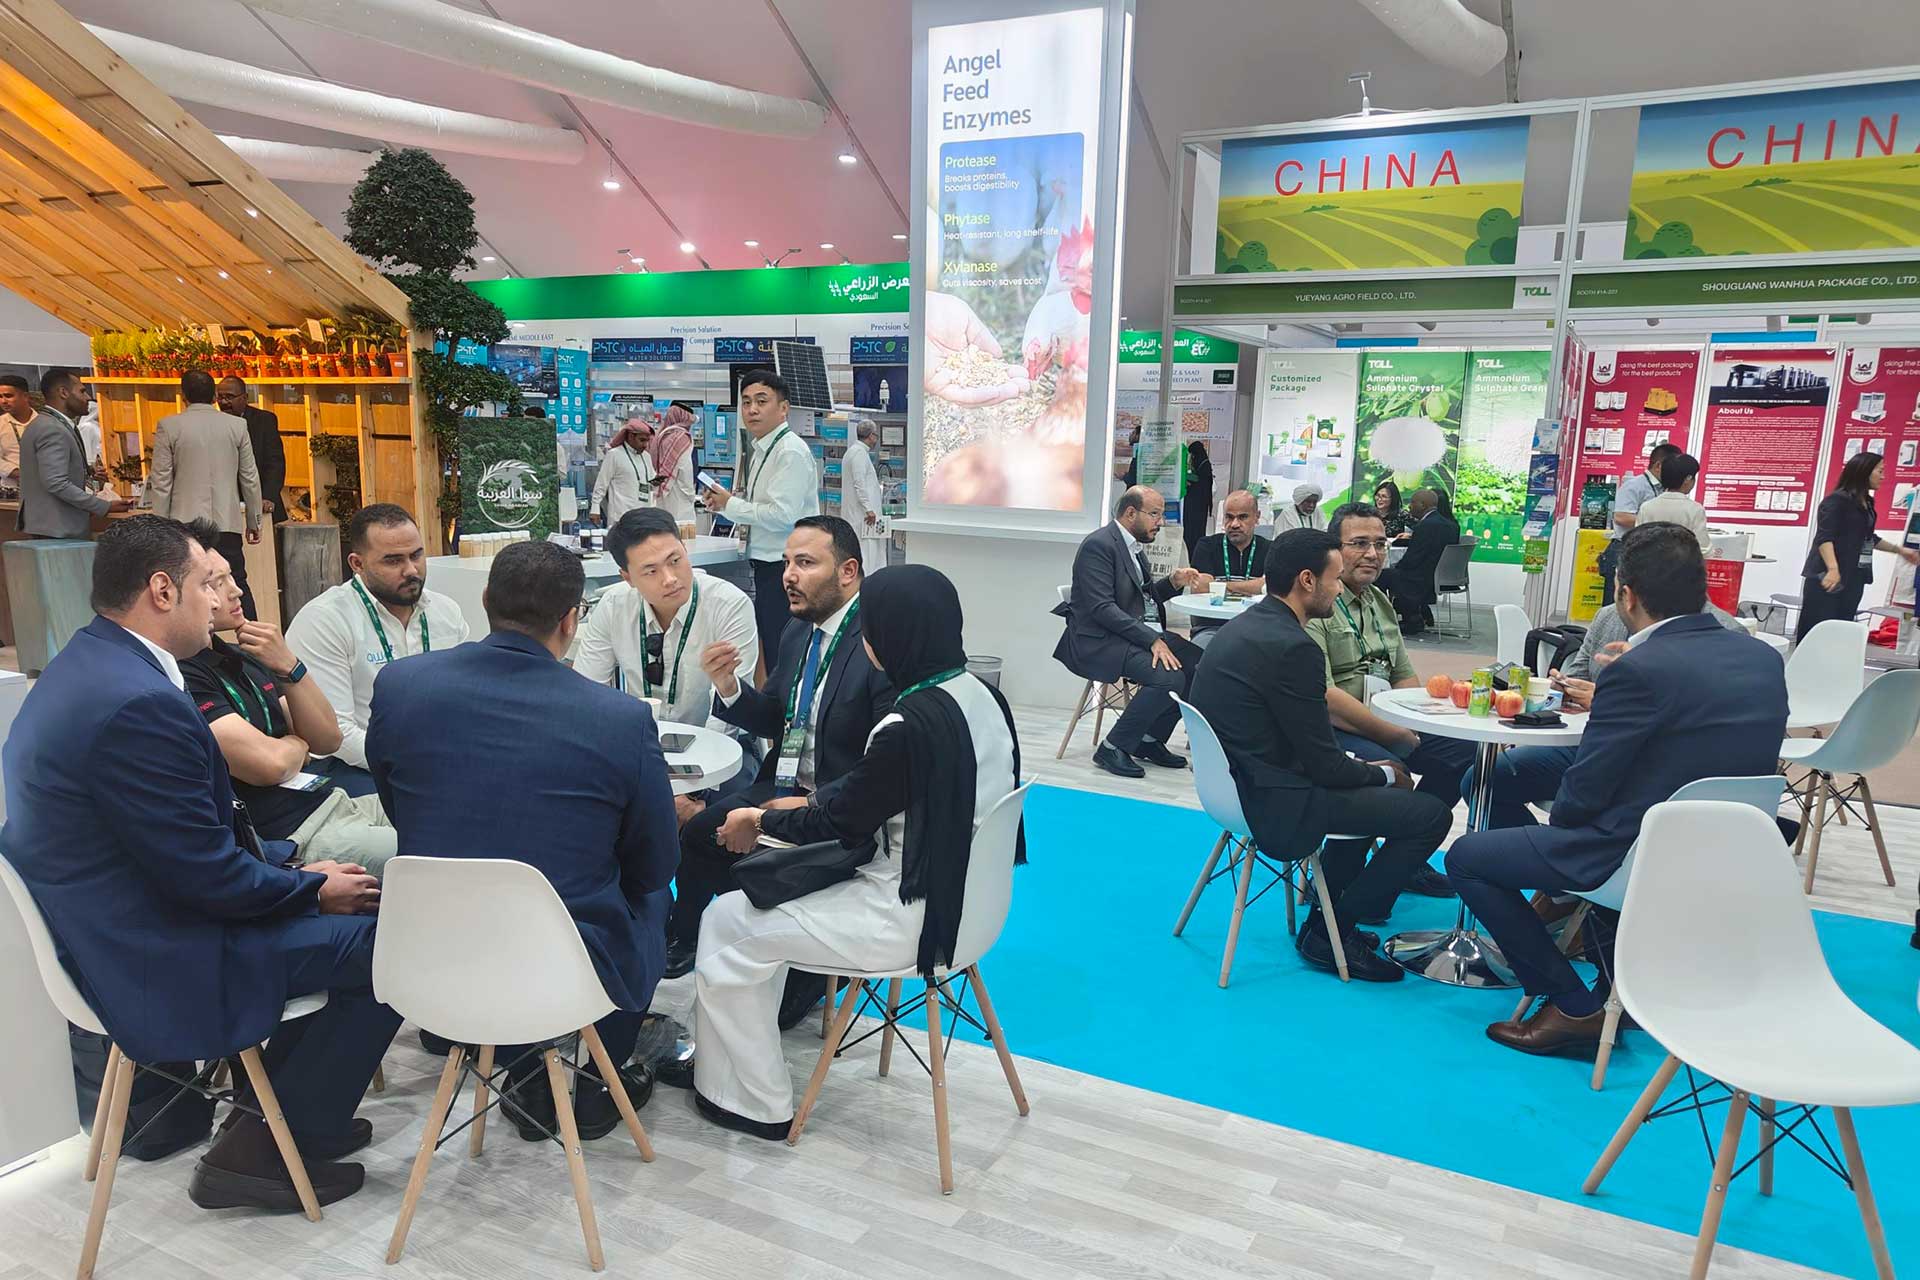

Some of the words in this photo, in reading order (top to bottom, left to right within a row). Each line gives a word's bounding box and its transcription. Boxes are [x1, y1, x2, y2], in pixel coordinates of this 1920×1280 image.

[943, 49, 1001, 76] Angel
[943, 79, 989, 102] Feed
[942, 108, 1031, 131] Enzymes
[1707, 113, 1920, 170] CHIN
[945, 155, 997, 169] Protease
[944, 173, 972, 183] Breaks
[972, 172, 1008, 183] proteins,
[1274, 149, 1462, 197] CHINA
[944, 182, 972, 192] boosts
[972, 180, 1020, 192] digestibility
[944, 213, 990, 227] Phytase
[1004, 229, 1022, 239] long
[944, 261, 997, 275] Xylanase
[842, 276, 879, 296] الزراعي
[943, 279, 961, 288] Cuts
[962, 278, 998, 288] viscosity,
[999, 278, 1022, 287] saves
[1023, 277, 1042, 286] cost
[1702, 282, 1767, 291] SHOUGUANG
[1769, 279, 1815, 289] WANHUA
[1817, 278, 1868, 288] PACKAGE
[1870, 276, 1893, 286] CO.,
[1896, 275, 1920, 285] LTD.
[849, 292, 879, 303] السعودي
[1295, 293, 1331, 302] YUEYANG
[1332, 292, 1356, 301] AGRO
[1357, 292, 1380, 301] FIELD
[1399, 291, 1417, 300] LTD.
[1522, 287, 1552, 297] TOLL
[670, 325, 697, 334] Precision
[697, 325, 722, 333] Solution
[870, 323, 901, 331] Precision
[689, 337, 714, 345] Compan
[716, 340, 745, 352] PSTC
[1128, 338, 1157, 352] الزراعي
[456, 345, 478, 355] PSTC
[593, 342, 619, 353] PSTC
[656, 343, 681, 354] حلول
[853, 341, 882, 353] PSTC
[558, 354, 574, 364] PSTC
[1368, 360, 1393, 369] TOLL
[1476, 359, 1504, 368] TOLL
[1270, 375, 1322, 383] Customized
[1366, 374, 1418, 383] Ammonium
[1474, 374, 1530, 382] Ammonium
[1270, 384, 1306, 393] Package
[1366, 384, 1407, 393] Sulphate
[1408, 384, 1444, 393] Crystal
[1474, 384, 1518, 393] Sulphate
[1718, 407, 1743, 415] About
